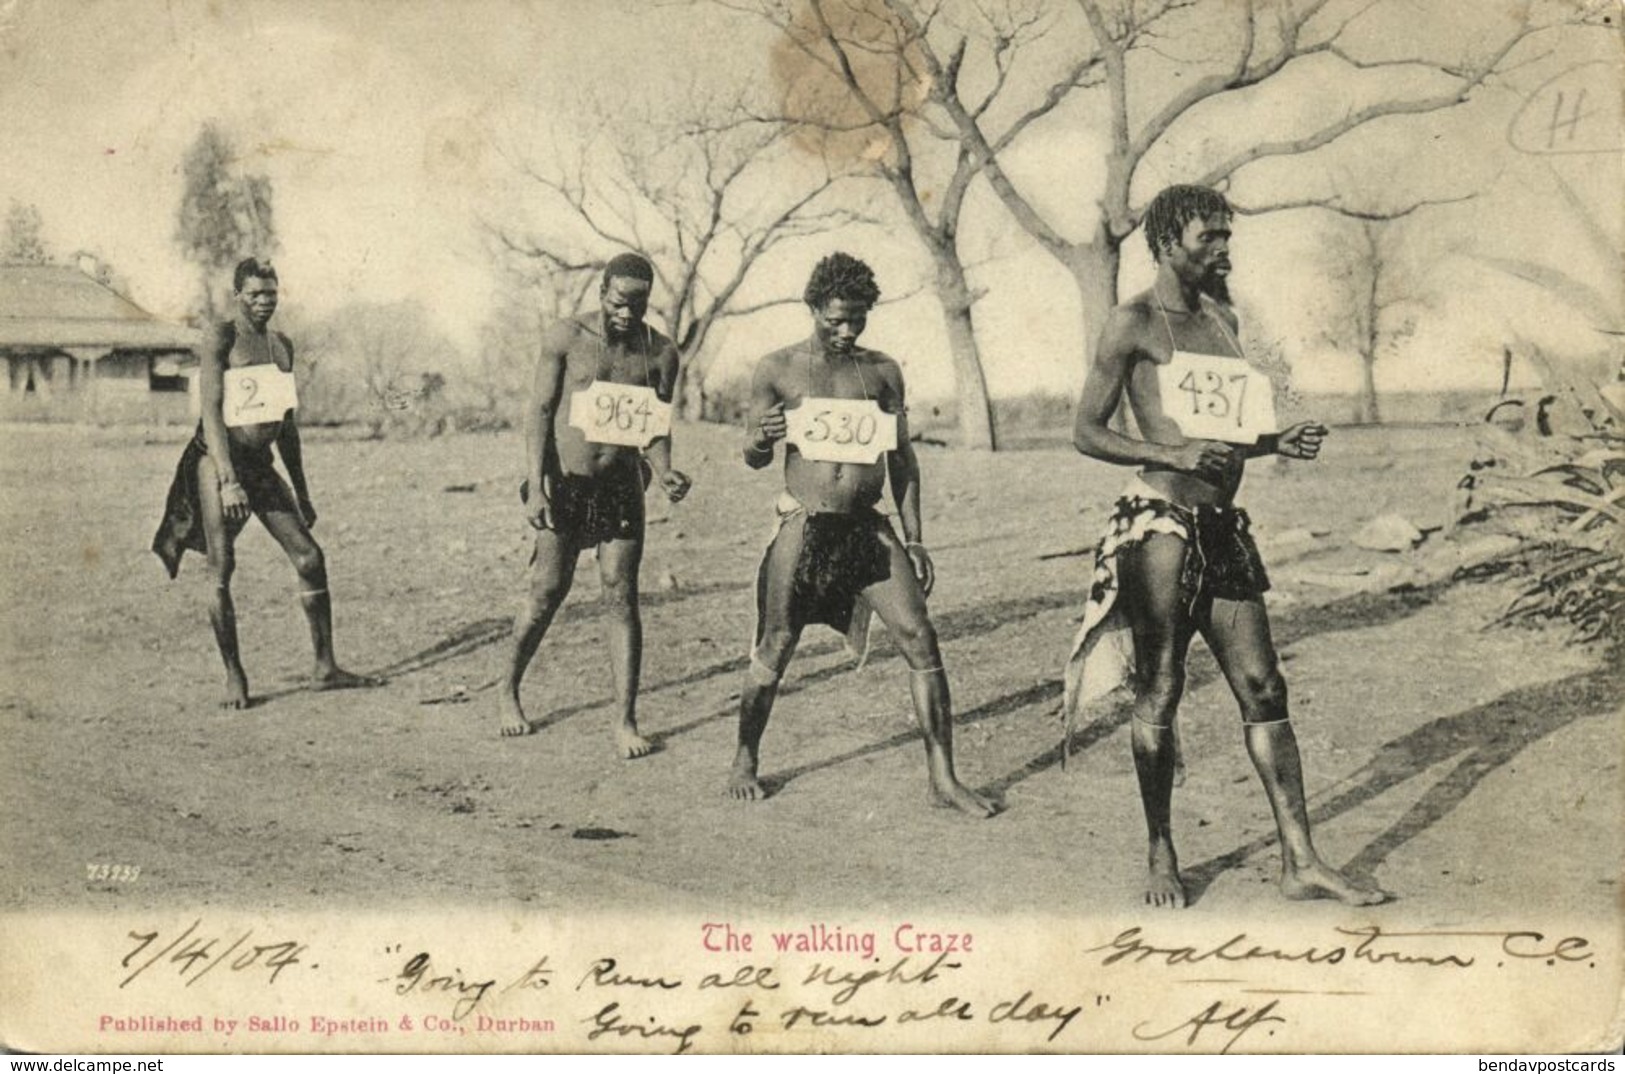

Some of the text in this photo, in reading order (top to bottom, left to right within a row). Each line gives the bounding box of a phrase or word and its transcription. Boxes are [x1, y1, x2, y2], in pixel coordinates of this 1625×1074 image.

[235, 377, 265, 416] 2
[592, 393, 654, 433] 964
[1178, 369, 1250, 428] 437
[804, 410, 877, 446] 530
[701, 923, 974, 958] The walking Craze
[507, 956, 552, 993] to
[699, 964, 780, 991] all
[99, 1015, 202, 1033] Published
[213, 1016, 238, 1036] by
[247, 1015, 300, 1033] Sallo
[310, 1015, 389, 1036] Epstein
[399, 1015, 414, 1033] &
[476, 1015, 556, 1033] Durban
[580, 1001, 703, 1054] Going
[729, 999, 756, 1035] to
[781, 1008, 886, 1030] run
[896, 998, 973, 1022] all
